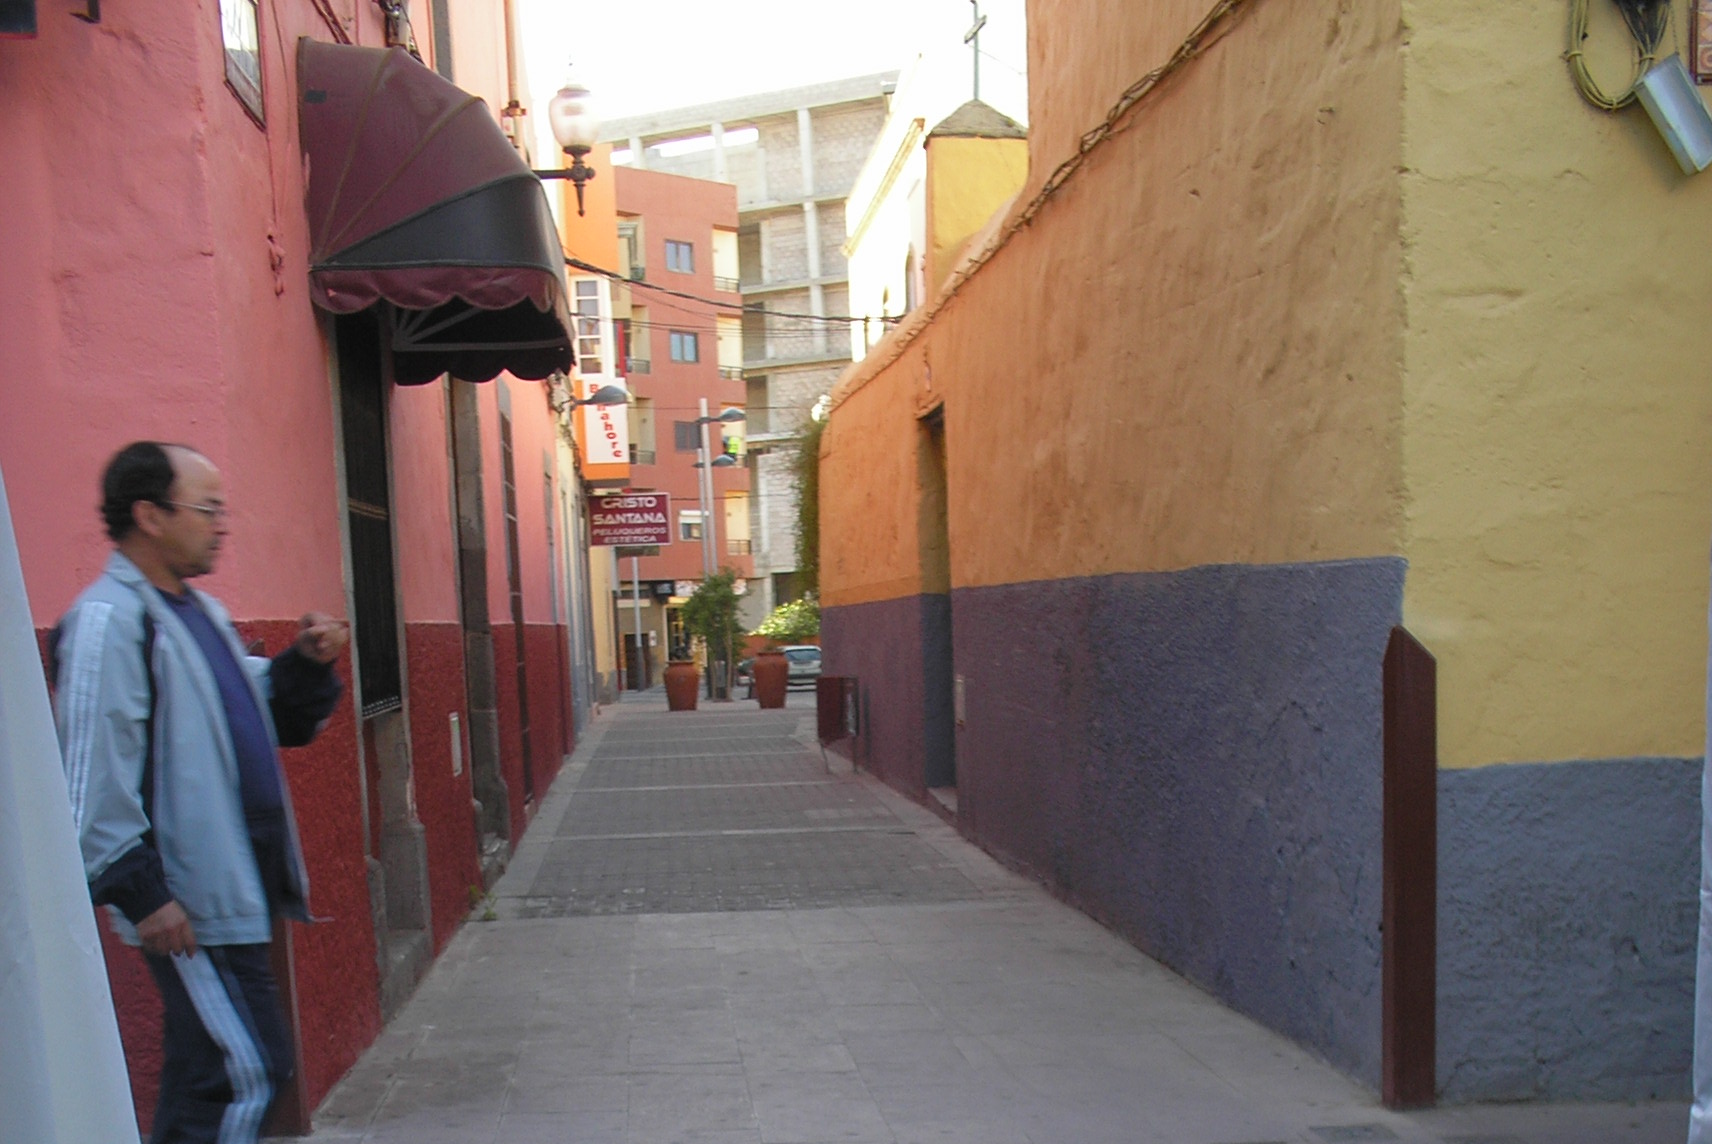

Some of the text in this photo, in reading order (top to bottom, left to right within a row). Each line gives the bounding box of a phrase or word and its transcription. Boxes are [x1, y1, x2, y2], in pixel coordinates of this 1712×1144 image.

[589, 384, 623, 458] Bnahore
[601, 497, 657, 509] CRISTO
[592, 512, 667, 525] SANTANA
